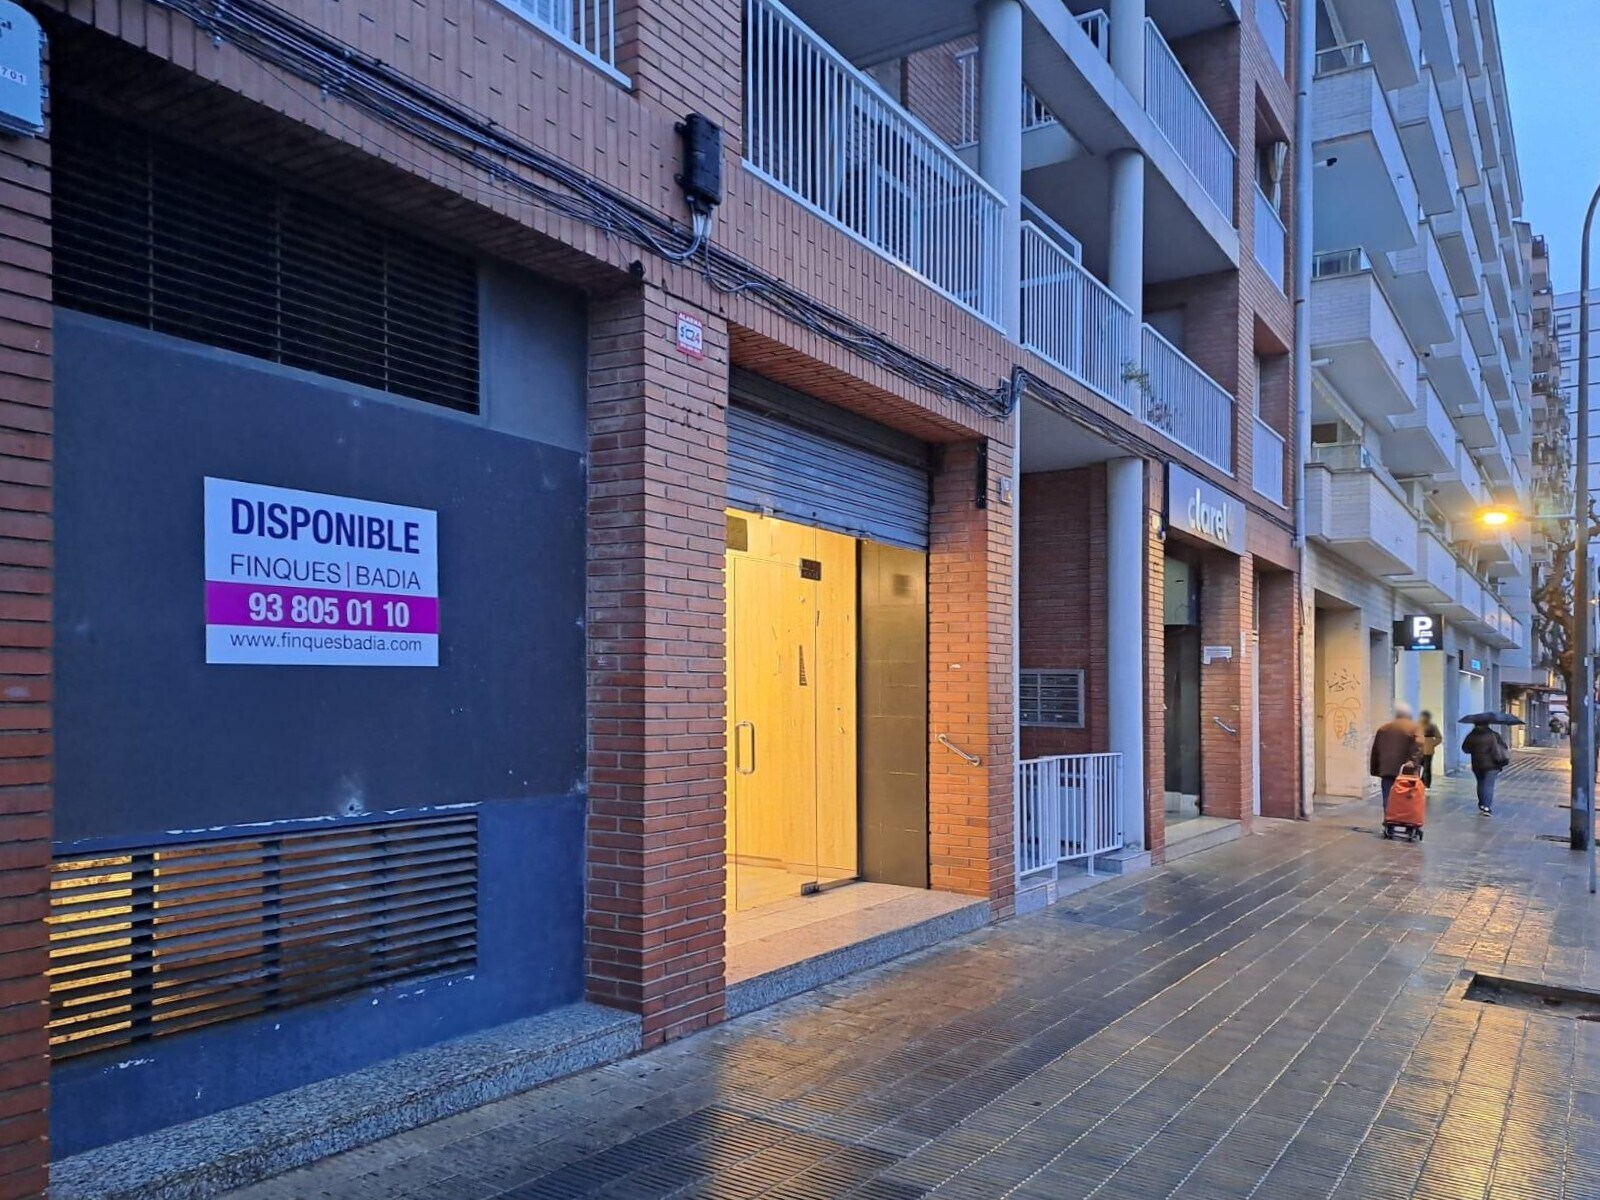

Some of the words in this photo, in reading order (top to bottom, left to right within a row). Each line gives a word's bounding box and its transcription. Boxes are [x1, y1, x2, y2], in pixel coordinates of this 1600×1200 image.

[231, 498, 420, 554] DISPONIBLE
[230, 554, 341, 583] FINQUES
[356, 566, 421, 590] BADIA
[249, 592, 283, 622] 93
[291, 595, 339, 624] 805
[346, 599, 373, 626] 01
[383, 602, 410, 628] 10
[1413, 616, 1433, 638] P
[230, 632, 422, 652] www.finquesbadia.com
